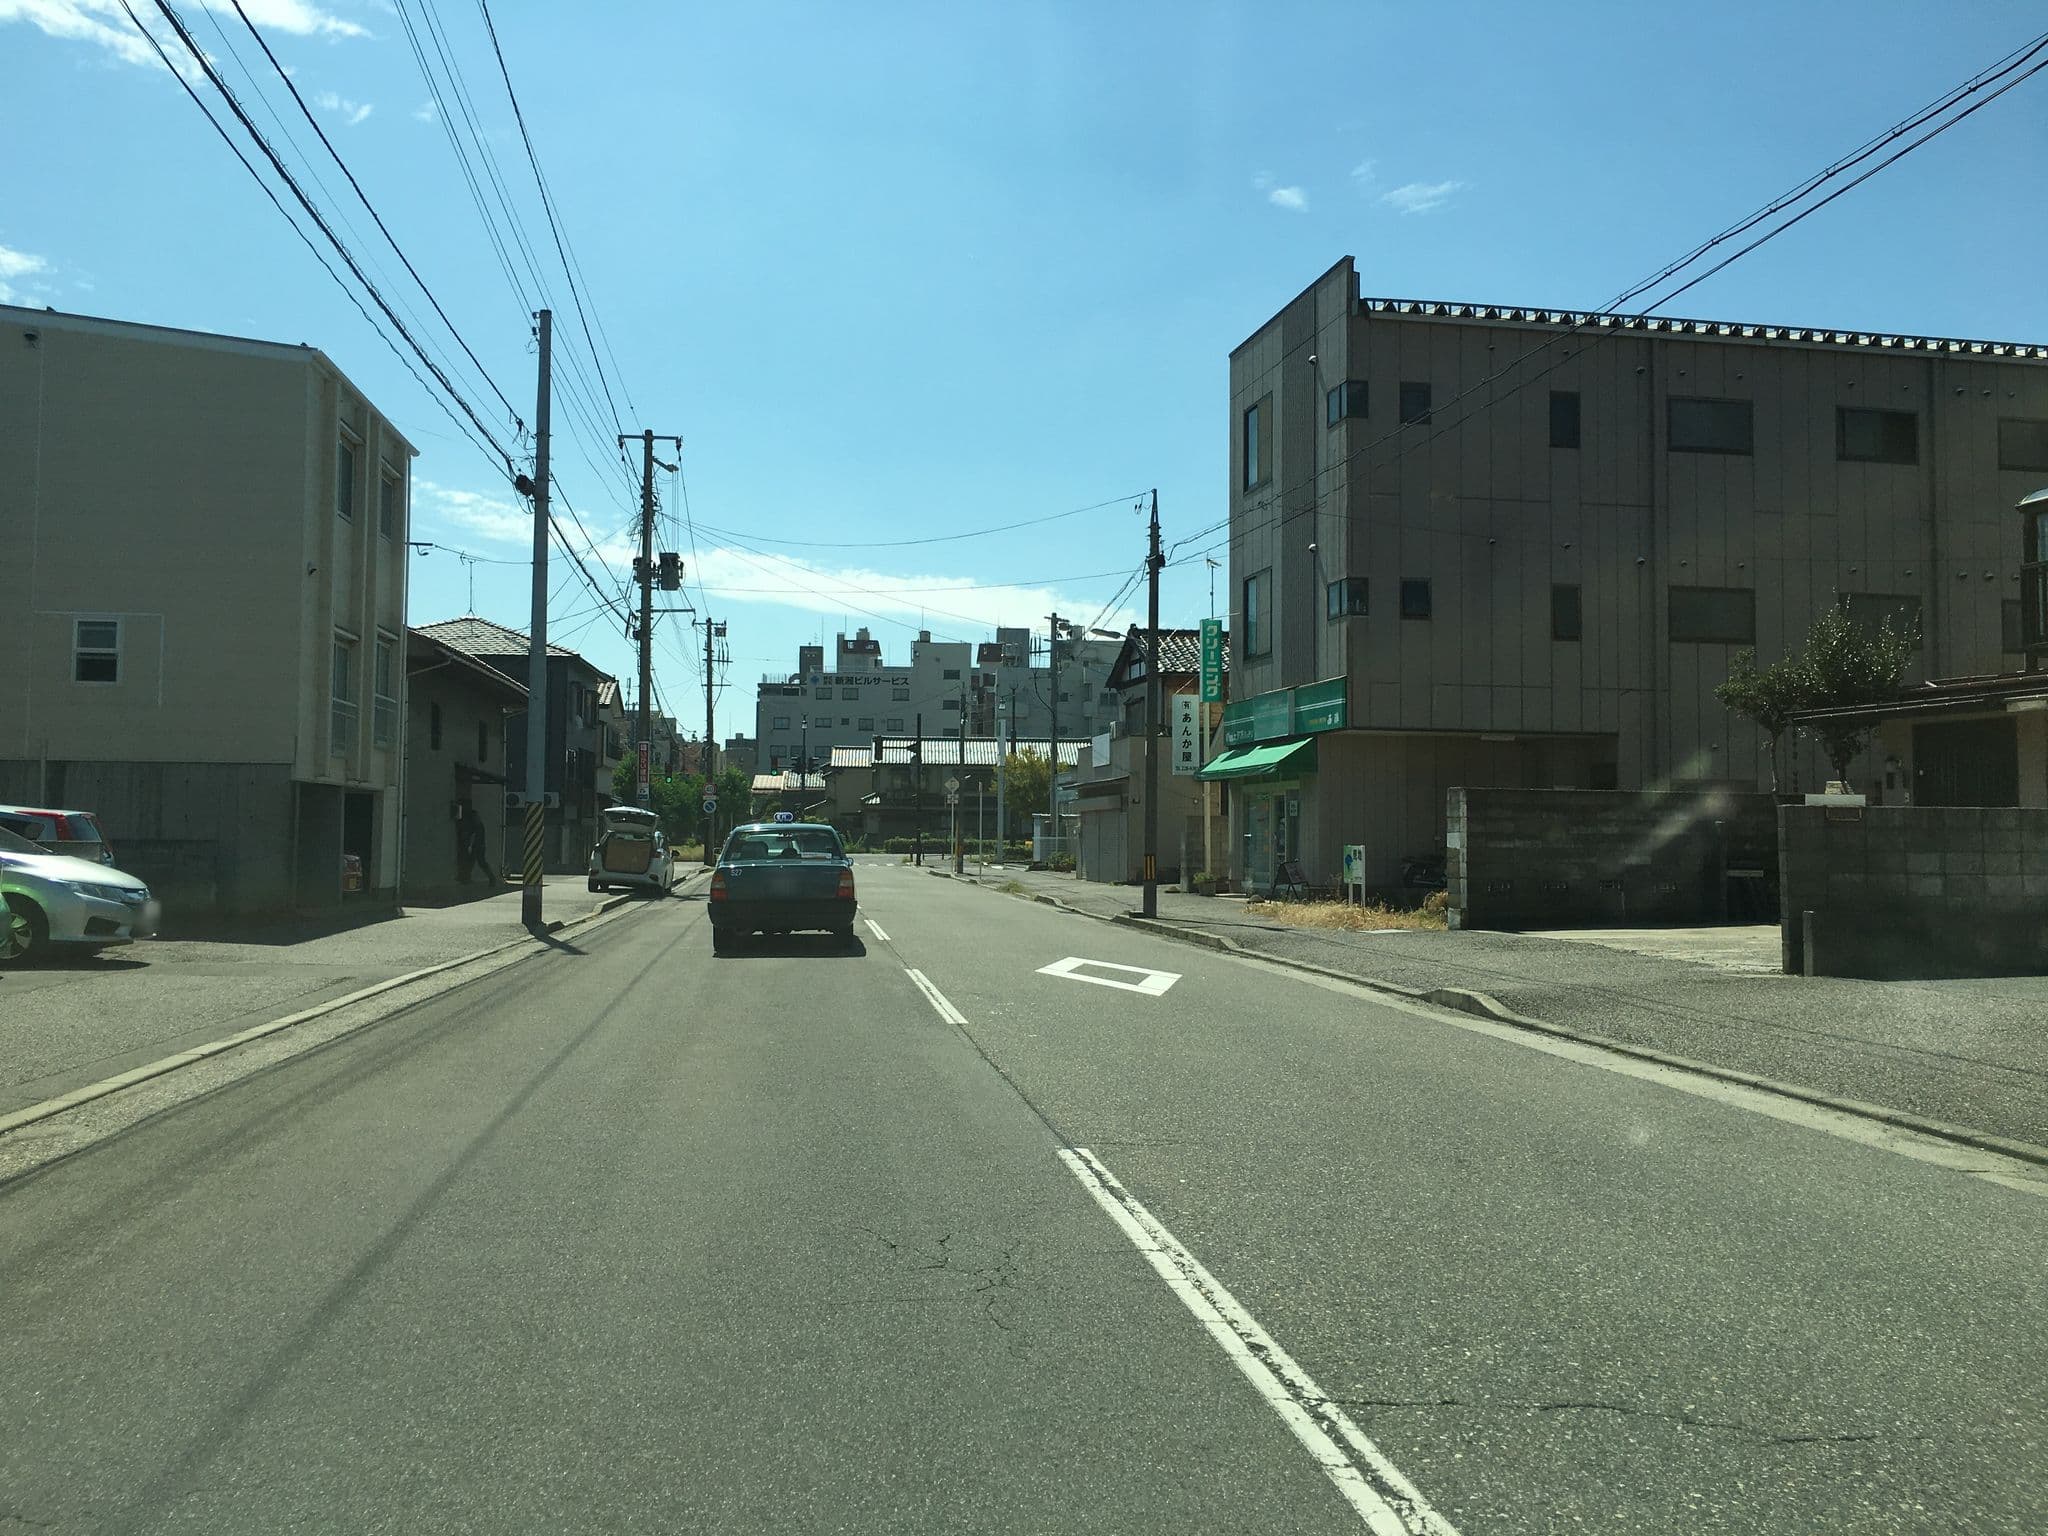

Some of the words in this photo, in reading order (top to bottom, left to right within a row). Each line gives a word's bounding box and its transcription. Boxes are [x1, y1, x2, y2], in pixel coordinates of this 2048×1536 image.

[1206, 625, 1221, 697] クリーニング
